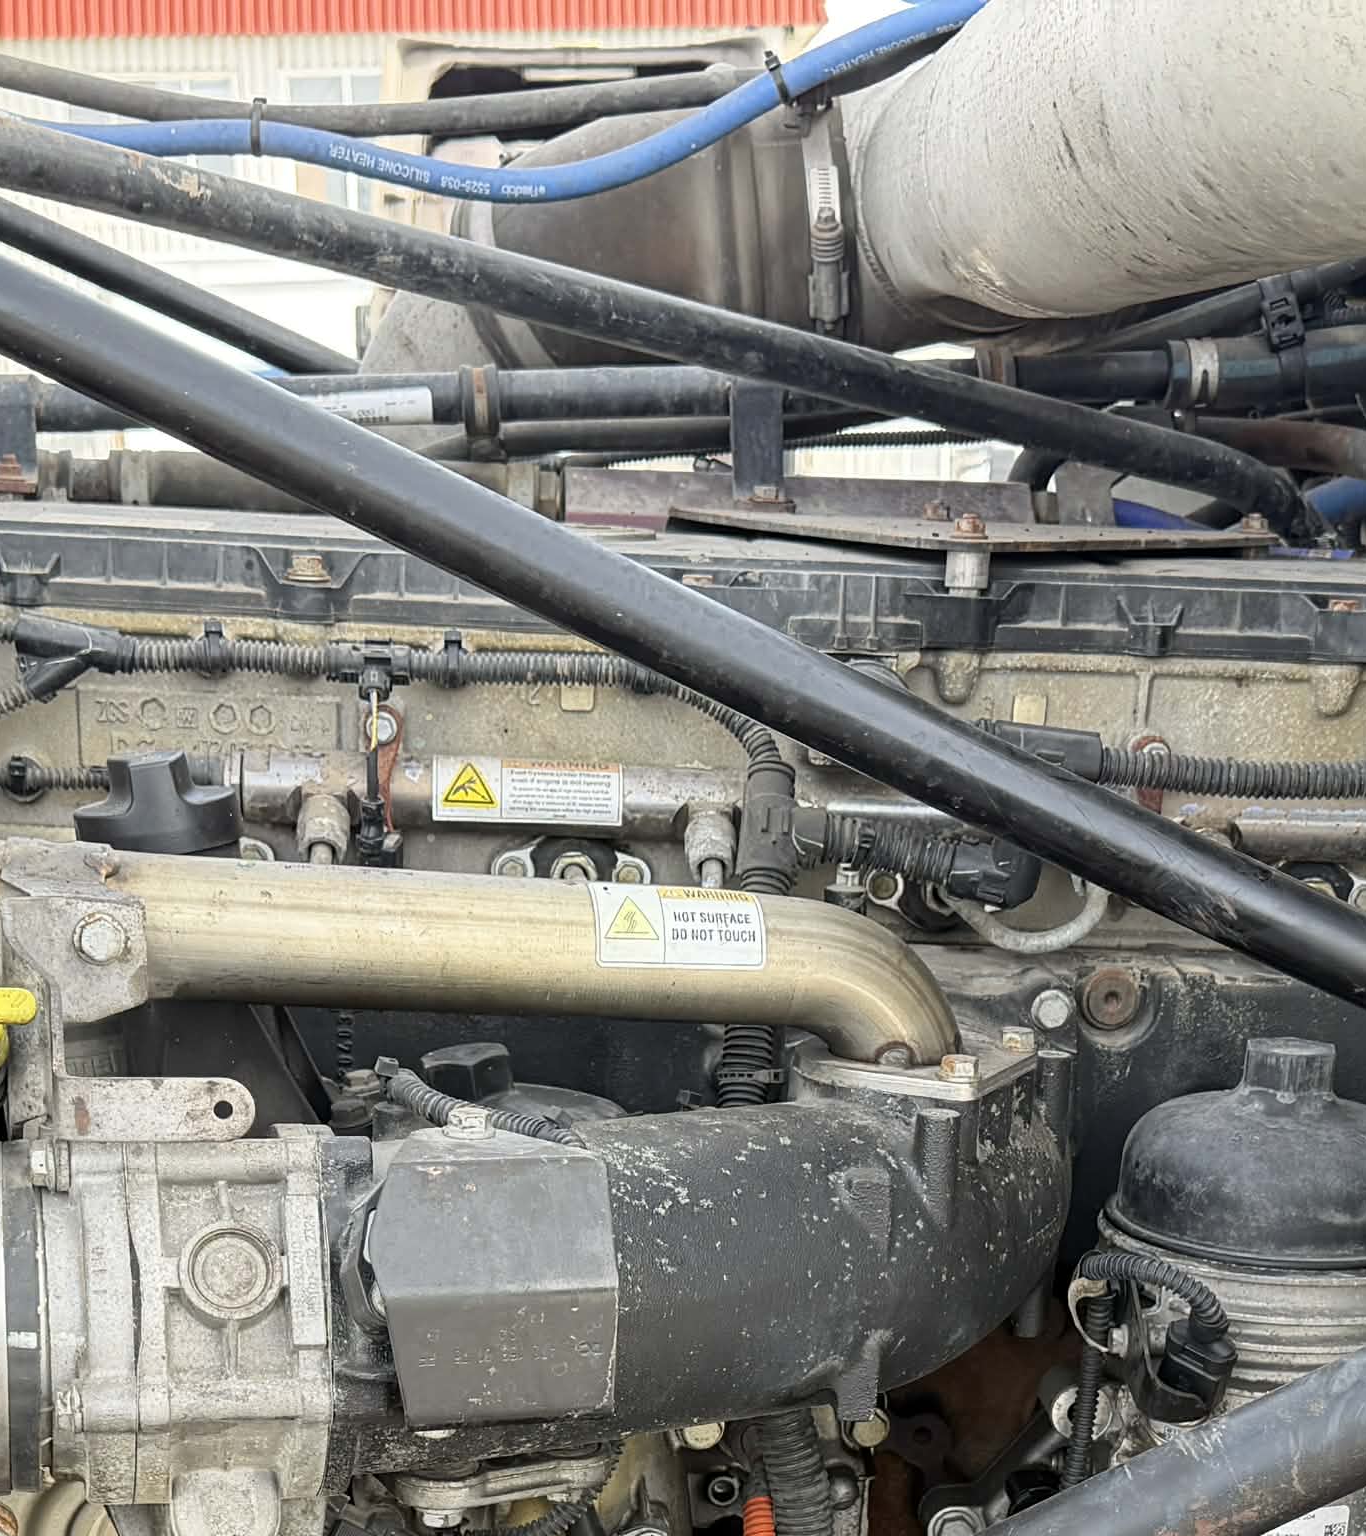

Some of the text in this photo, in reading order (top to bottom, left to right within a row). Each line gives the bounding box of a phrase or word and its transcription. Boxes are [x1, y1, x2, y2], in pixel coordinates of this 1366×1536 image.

[329, 143, 375, 169] HEATER
[377, 162, 430, 184] SILICONE
[683, 888, 749, 902] WARNING
[673, 911, 753, 927] HOT SURFACE
[672, 928, 756, 943] DO NOT TOUCH
